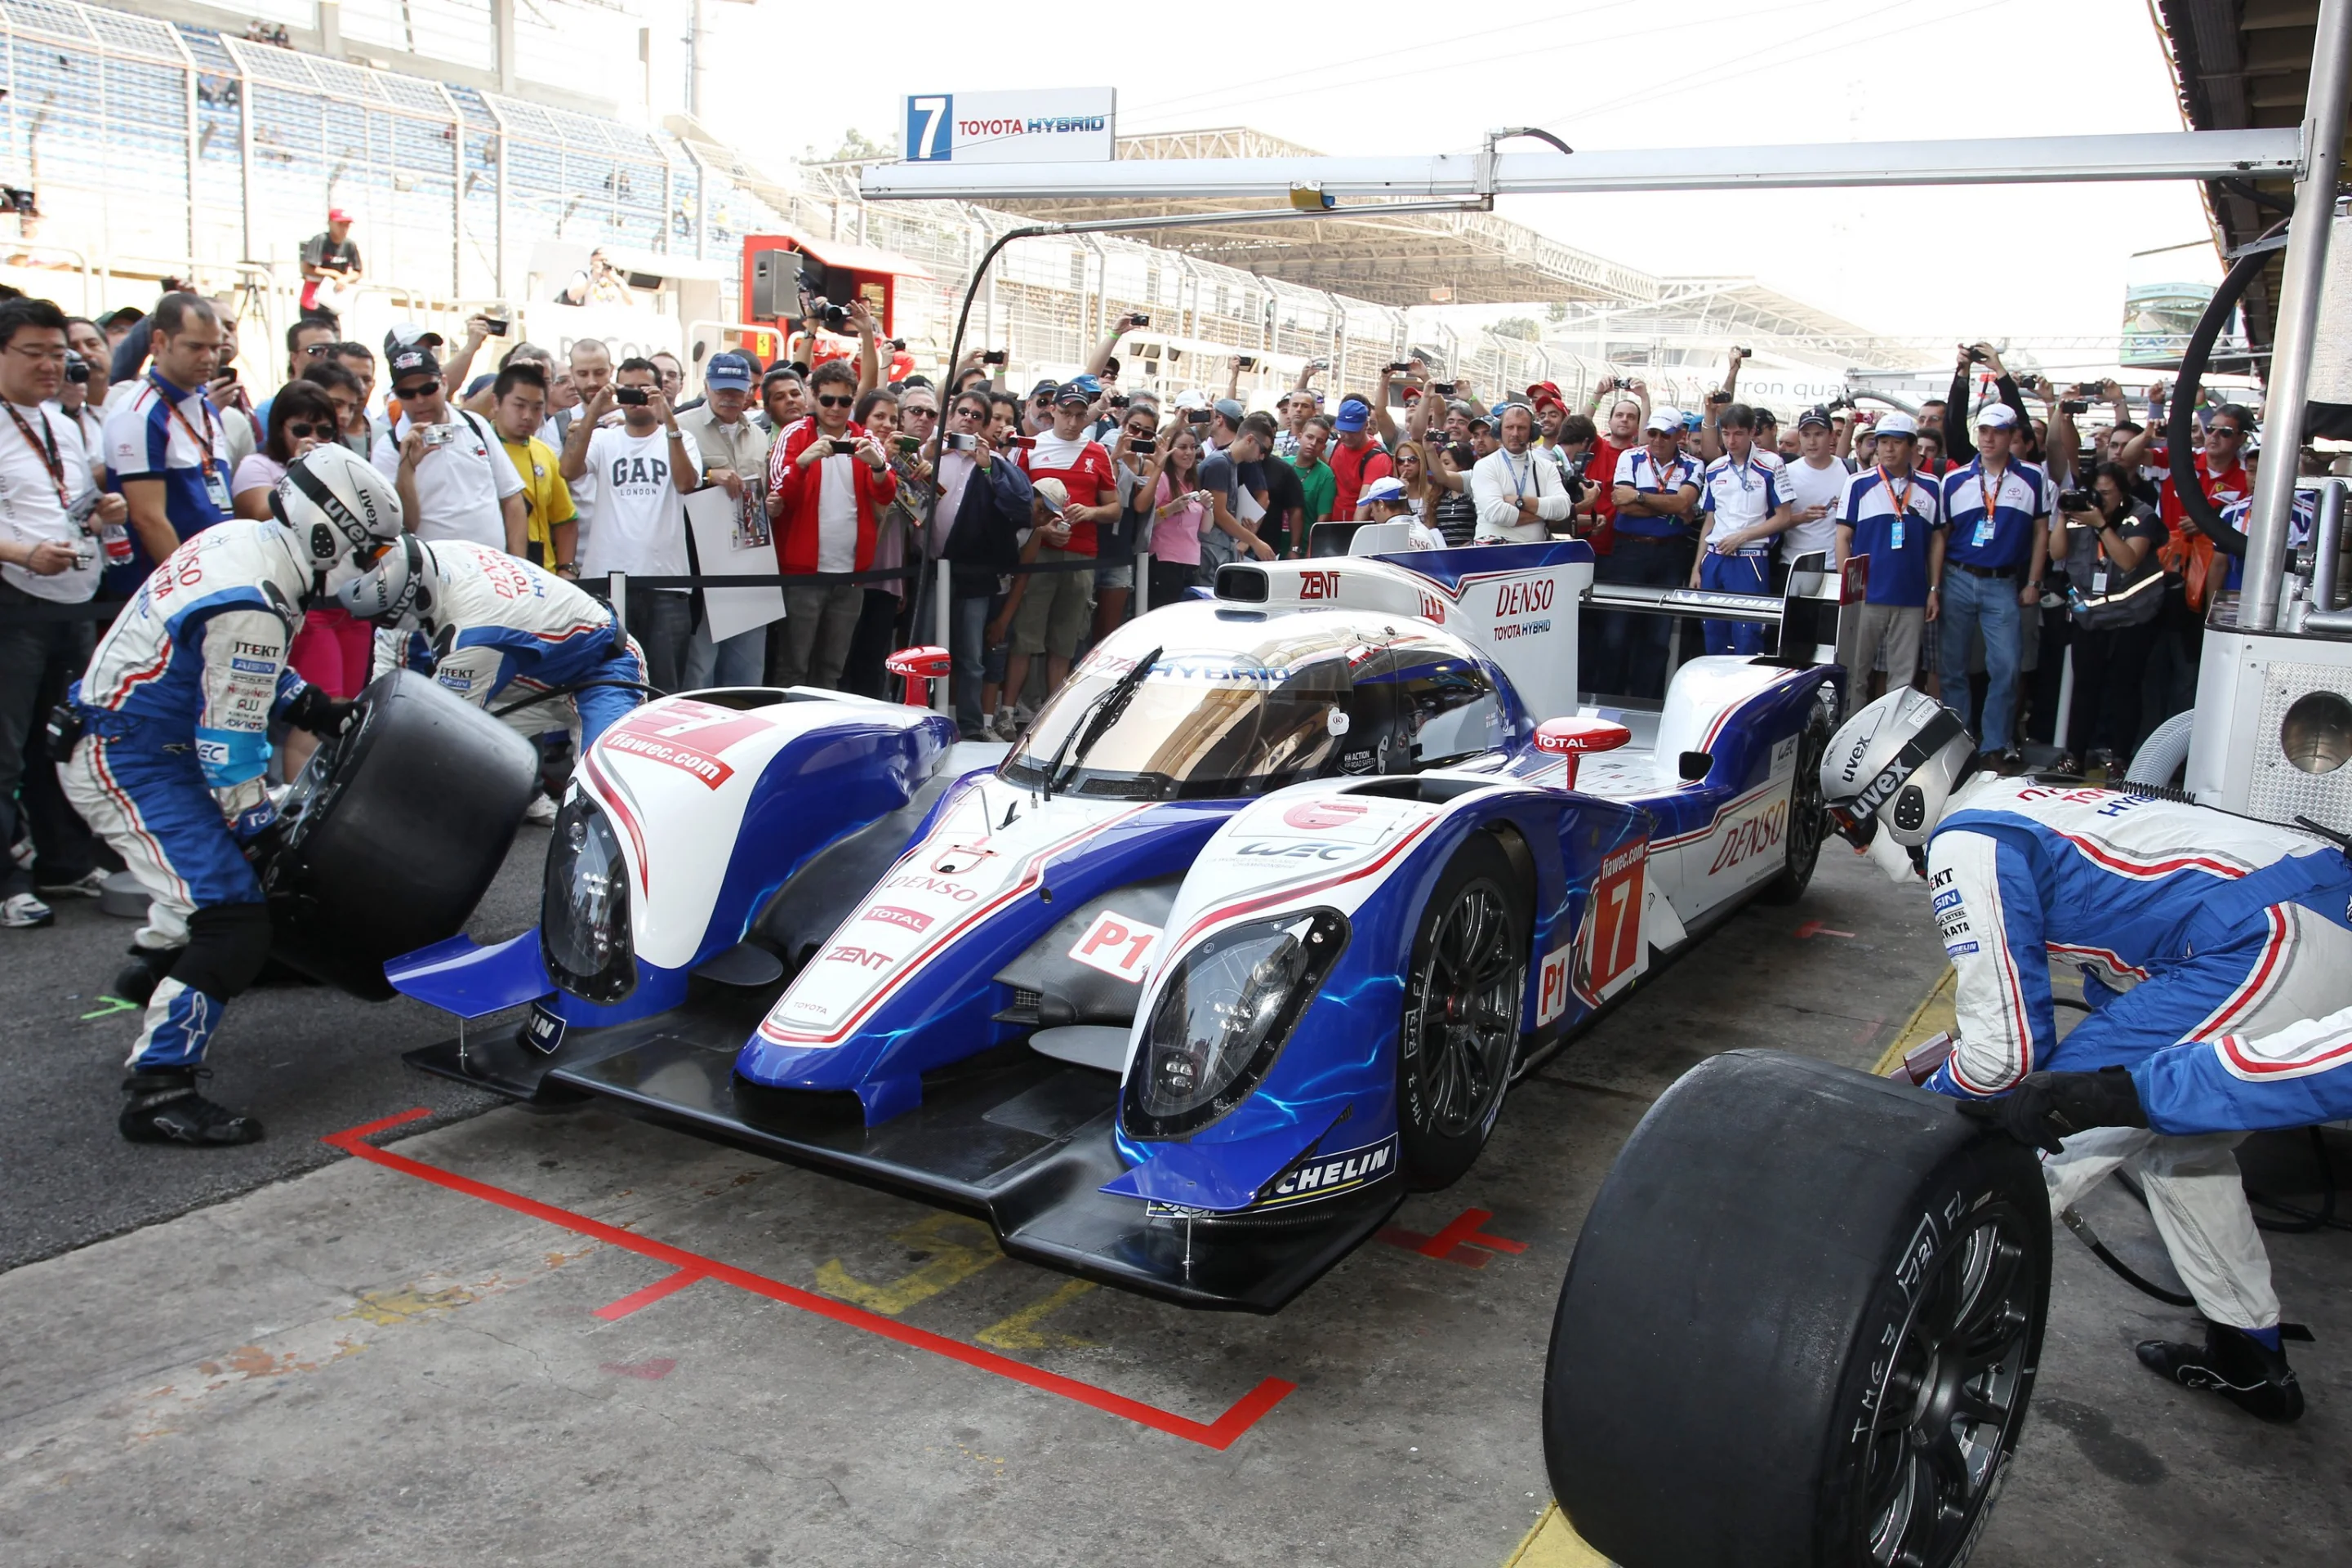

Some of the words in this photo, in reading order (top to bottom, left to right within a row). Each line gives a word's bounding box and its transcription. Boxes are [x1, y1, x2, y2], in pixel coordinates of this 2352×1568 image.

[915, 97, 946, 159] 7
[959, 119, 1023, 136] TOYOTA
[1027, 116, 1104, 133] HYBRID
[612, 457, 667, 487] GAP
[621, 488, 657, 497] LONDON
[359, 489, 378, 528] uvex
[323, 496, 376, 553] uvex
[177, 537, 203, 586] ENSO
[376, 580, 387, 608] uvex
[387, 572, 421, 619] uvex
[1299, 571, 1341, 599] ZENT
[1495, 579, 1554, 617] DENSO
[1704, 596, 1784, 609] MICHEL
[1494, 624, 1521, 641] TOYOTA
[1521, 619, 1551, 637] HYBRID
[234, 641, 279, 657] JTEKT
[885, 658, 916, 672] OTAL
[1144, 662, 1291, 681] HYBRID
[198, 744, 225, 760] EC
[1538, 734, 1588, 748] TOTAL
[1777, 738, 1795, 761] WEC
[607, 733, 720, 781] fiawec.com
[1351, 759, 1362, 767] ROAD
[1362, 757, 1376, 766] SAFETY
[1352, 751, 1370, 761] ACTION
[1842, 735, 1871, 783] uvex
[1850, 757, 1913, 820] uvex
[2097, 795, 2156, 817] HYB
[1708, 799, 1786, 875] DENSO
[1236, 842, 1356, 861] WEC
[1602, 843, 1644, 880] fiawec.com
[885, 876, 978, 902] DENSO
[1929, 867, 1953, 892] EKT
[1935, 892, 1957, 911] SIN
[871, 908, 924, 929] TOTAL
[1607, 878, 1631, 977] 7
[1945, 911, 1966, 920] STEEL
[1943, 922, 1970, 939] KATA
[825, 946, 893, 970] ZENT
[1080, 920, 1154, 970] P1
[1541, 957, 1566, 1016] P1
[793, 1001, 827, 1014] TOYOTA
[1410, 1093, 1423, 1126] TMG
[1276, 1146, 1390, 1194] CHELIN
[1851, 1360, 1883, 1443] TMG
[1882, 1323, 1896, 1345] 7
[1944, 1191, 1967, 1231] FL
